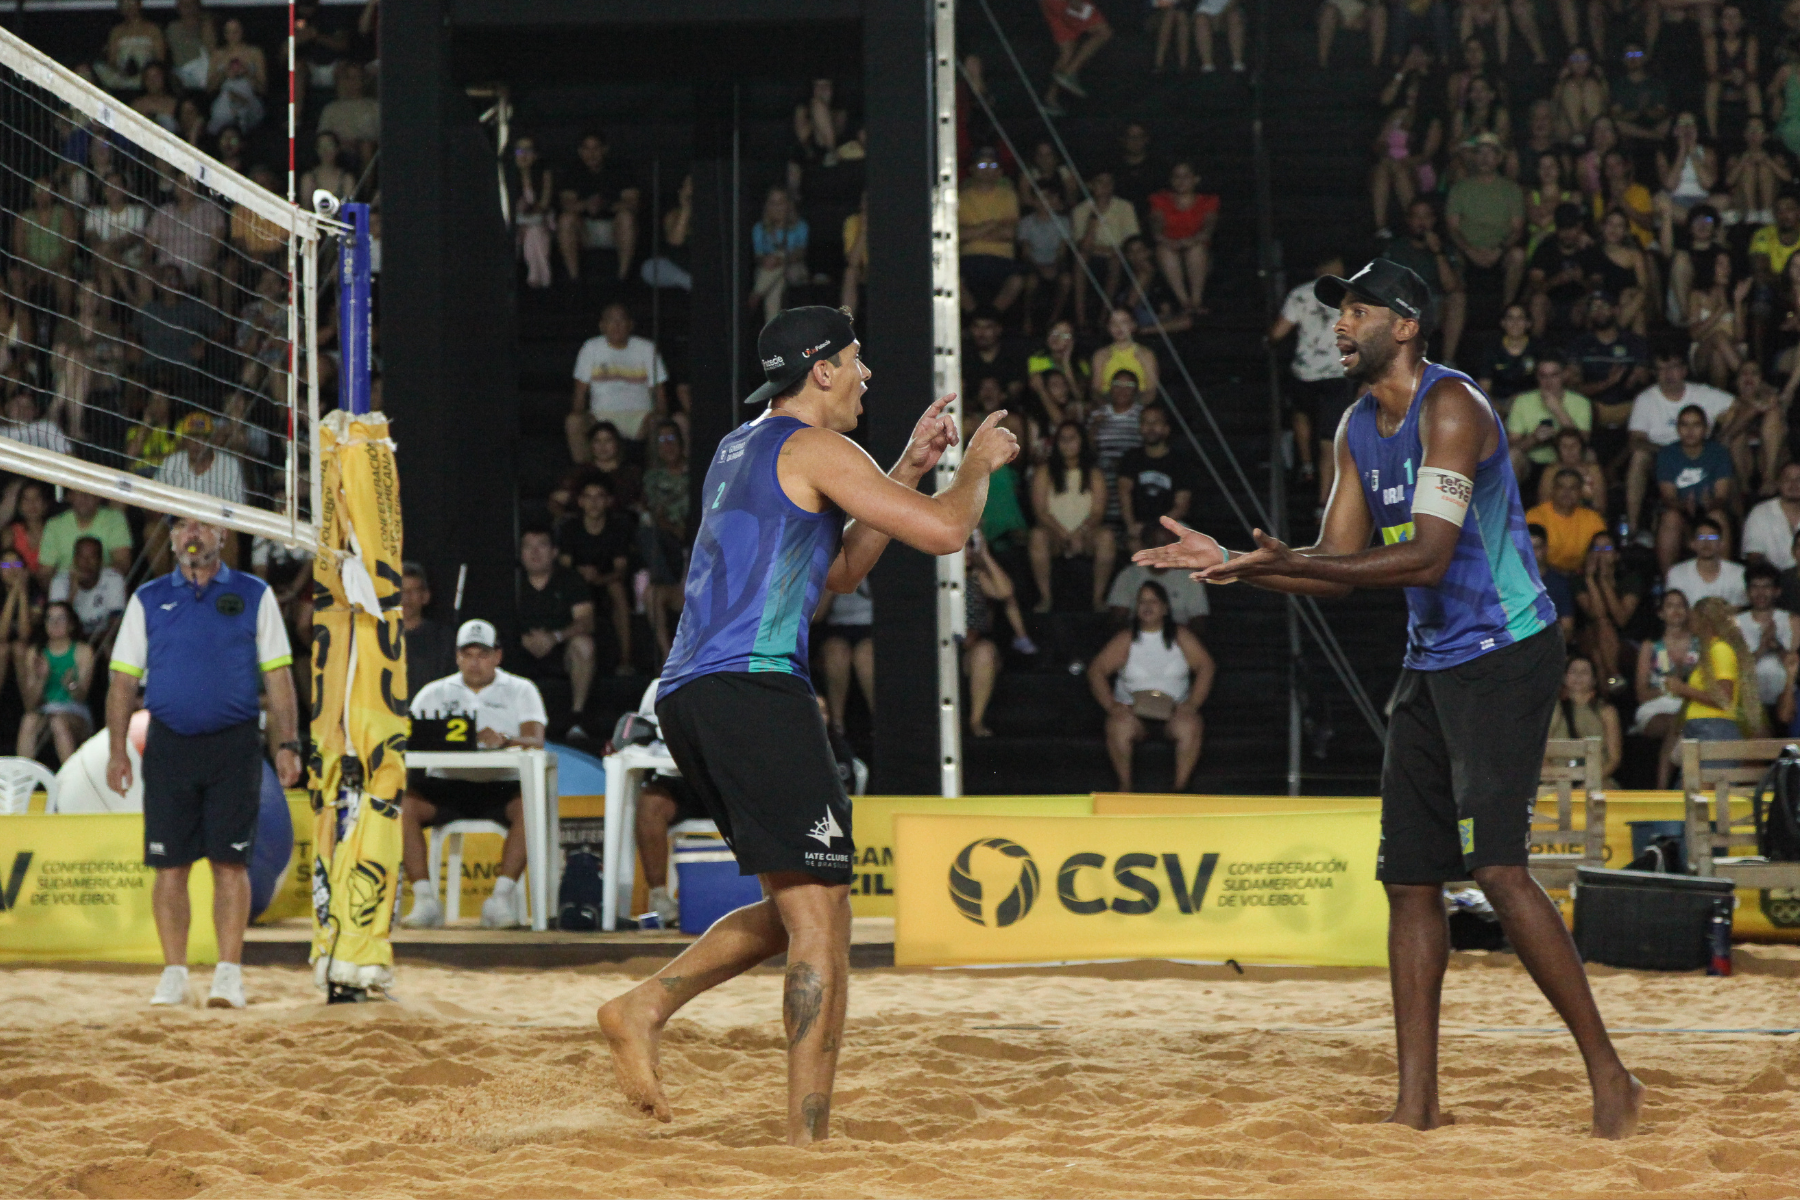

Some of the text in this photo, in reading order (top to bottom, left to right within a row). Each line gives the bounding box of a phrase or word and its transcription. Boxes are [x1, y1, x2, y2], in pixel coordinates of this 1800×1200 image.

[1403, 457, 1414, 485] 1
[711, 481, 726, 510] 2
[445, 717, 469, 742] 2
[804, 851, 825, 861] IATE
[825, 853, 849, 862] CLUBE
[1227, 858, 1347, 876] CONFEDERACIÓN
[36, 876, 144, 891] SUDAMERICANA
[1056, 852, 1221, 916] CSV
[1222, 877, 1334, 893] SUDAMERICANA
[30, 892, 119, 906] DE VOLEIBOL
[1217, 894, 1308, 908] DE VOLEIBOL
